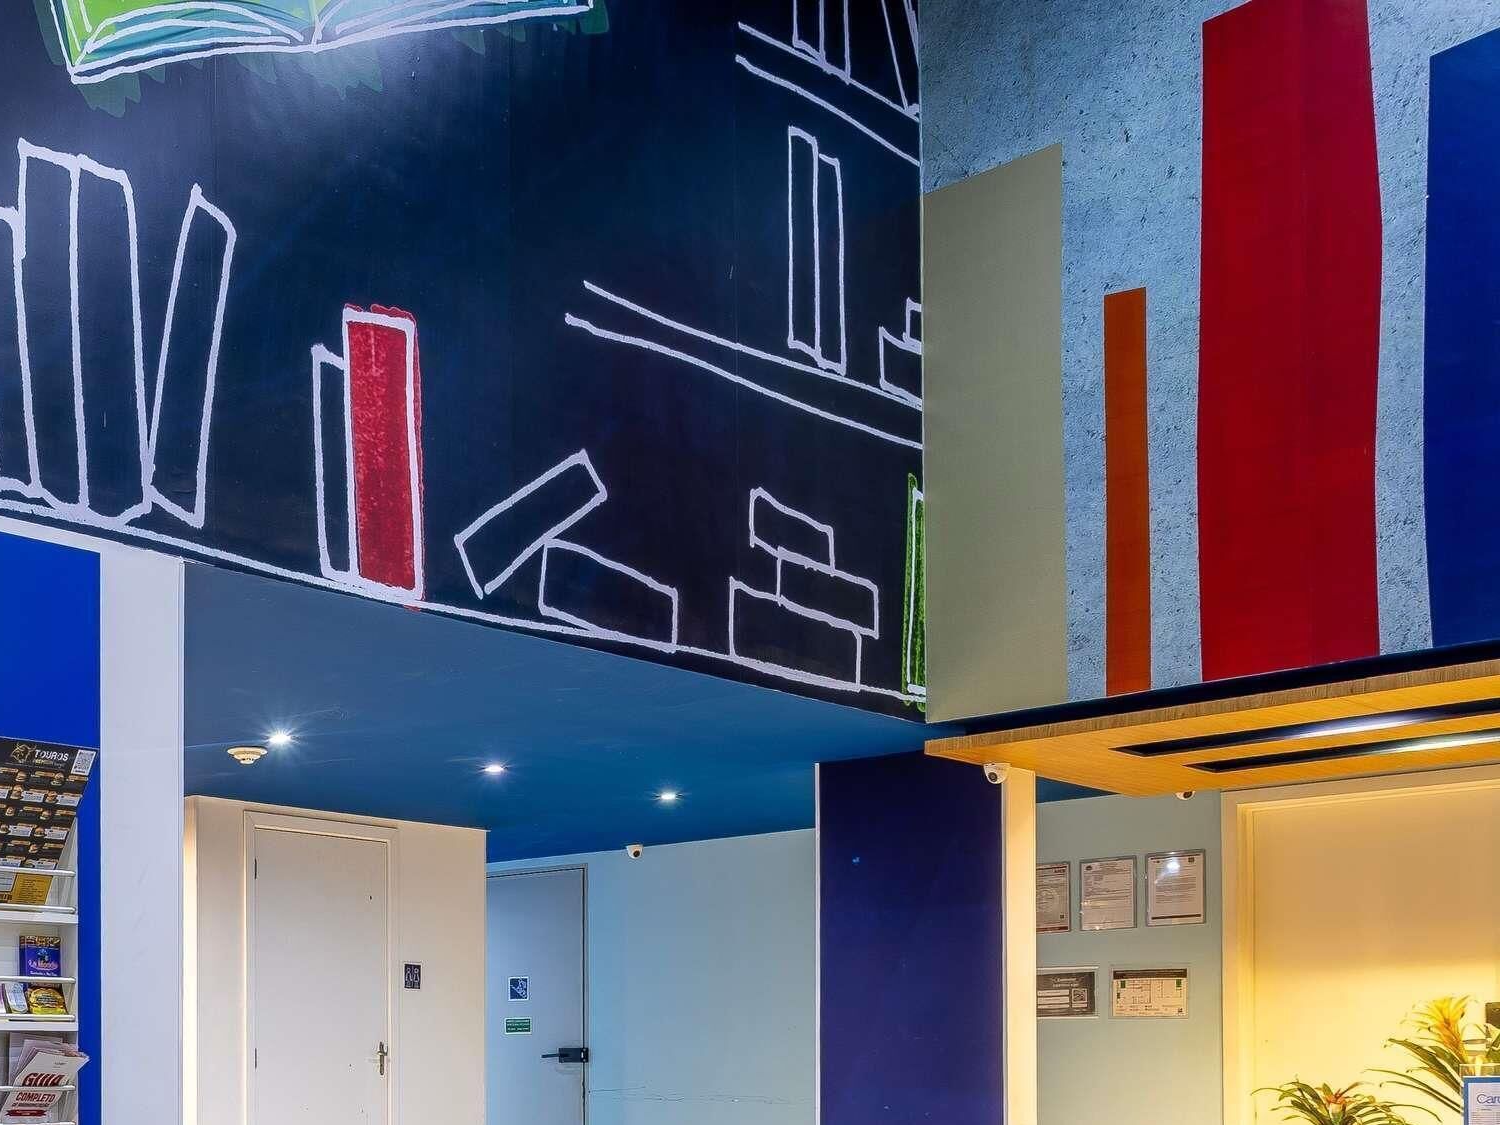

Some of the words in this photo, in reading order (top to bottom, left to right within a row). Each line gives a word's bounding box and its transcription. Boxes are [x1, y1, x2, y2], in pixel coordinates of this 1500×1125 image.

[35, 749, 69, 762] TOUROS
[22, 1072, 65, 1088] GUIA
[15, 1092, 56, 1103] COMPLETO
